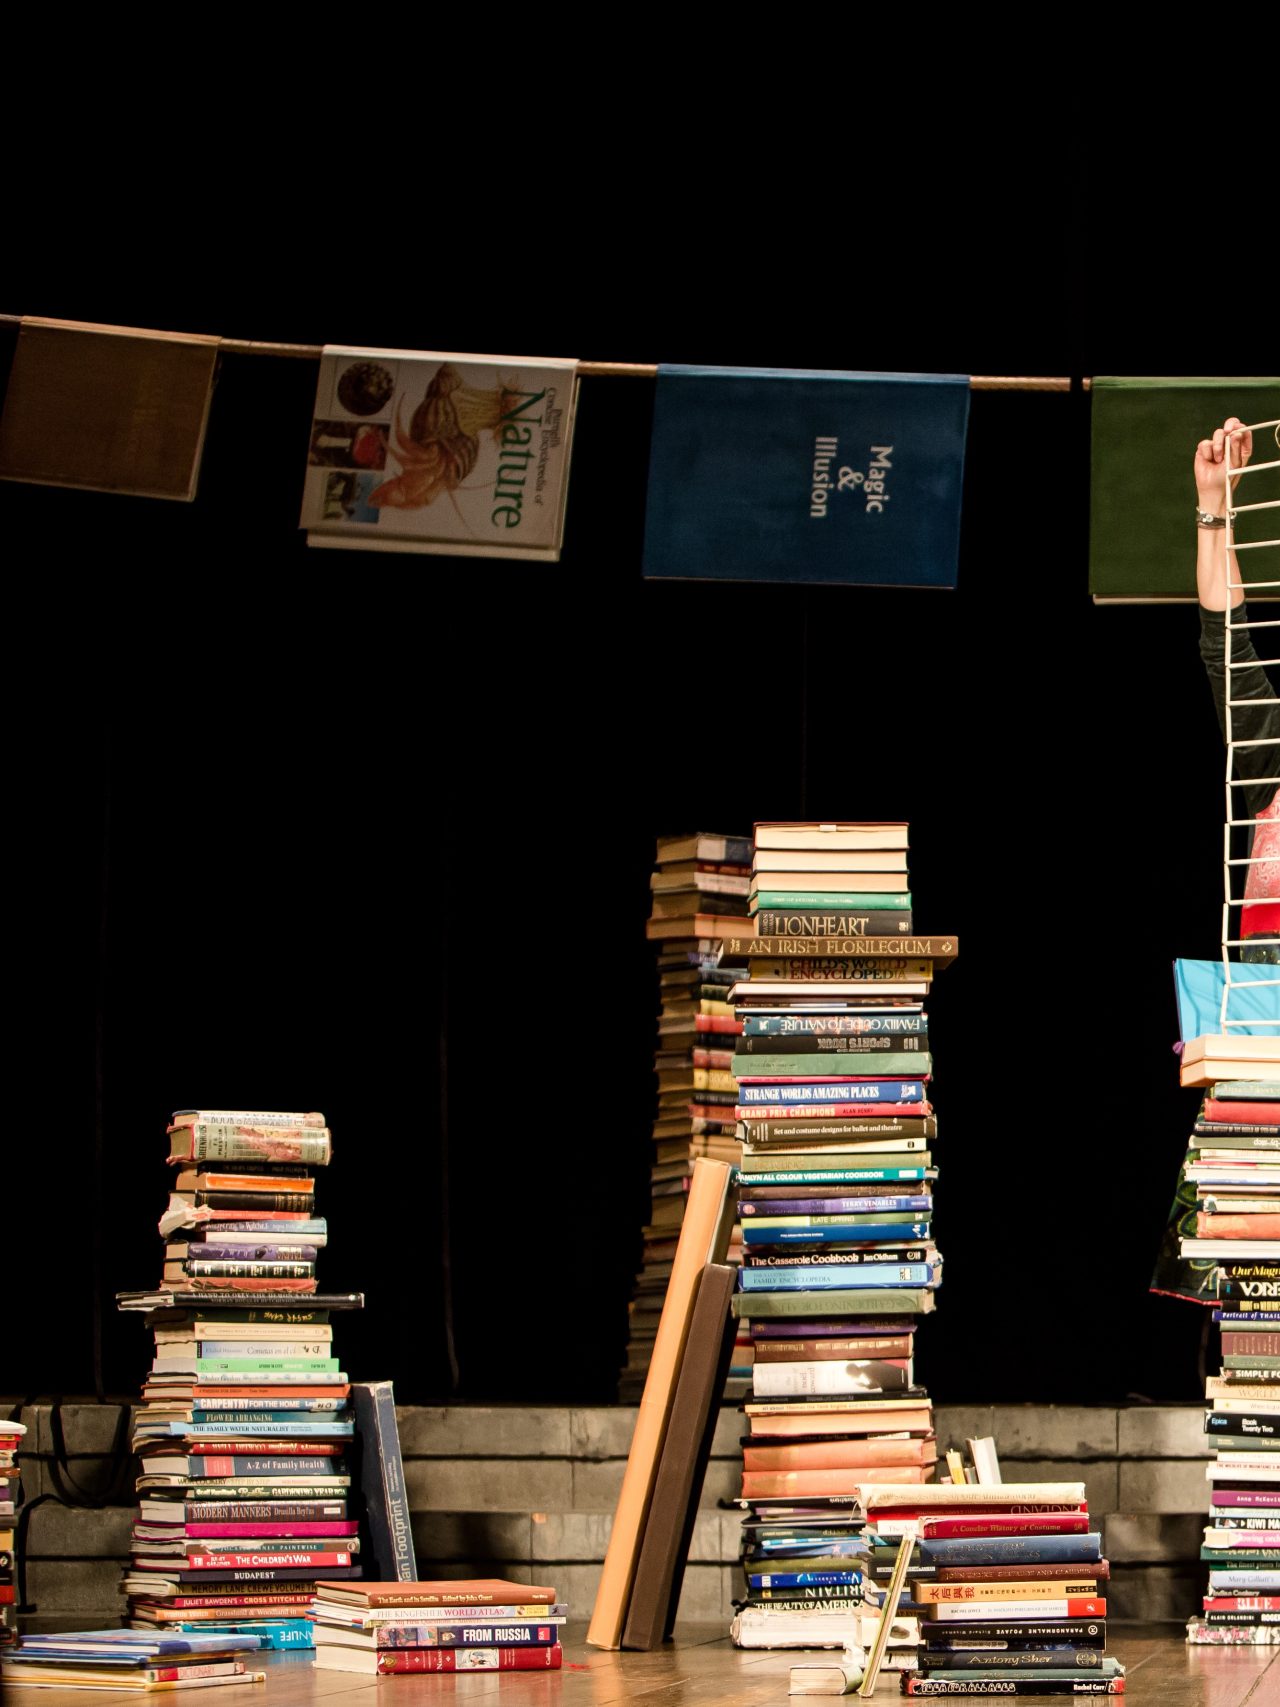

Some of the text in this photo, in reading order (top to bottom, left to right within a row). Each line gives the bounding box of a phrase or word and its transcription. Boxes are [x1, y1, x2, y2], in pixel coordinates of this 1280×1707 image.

[491, 387, 546, 528] Nature
[810, 435, 838, 519] Illusion
[836, 465, 865, 492] &
[866, 445, 894, 515] Magic
[775, 916, 869, 936] LIONHEART
[747, 939, 931, 955] AN IRISH FLORILEGIUM
[789, 958, 907, 970] CHILD'S WORLD
[790, 969, 908, 980] ENCYCLOPEDIA
[781, 1019, 920, 1031] FAMILY GUIDE TO NATURE
[849, 1037, 890, 1049] SPORTS
[745, 1086, 879, 1100] STRANGE WORLDS AMAZING PLACES
[740, 1107, 835, 1119] GRAND PRIX CHAMPIONS
[819, 1126, 842, 1135] designs
[869, 1124, 880, 1132] and
[803, 1172, 844, 1180] VEGETARIAN
[844, 1171, 884, 1179] COOKBOOK
[842, 1199, 896, 1208] TERRY VENABLES
[750, 1254, 859, 1266] The Casserole Cookbook
[1232, 1266, 1252, 1276] Our
[1236, 1370, 1269, 1378] SIMPLE
[200, 1399, 249, 1409] CARPENTRY
[1211, 1418, 1227, 1426] Epica
[1242, 1418, 1257, 1426] Book
[1242, 1425, 1261, 1433] Twenty
[272, 1462, 298, 1470] Family
[192, 1507, 271, 1519] MODERN MANNERS
[990, 1524, 1017, 1533] History
[1247, 1519, 1266, 1528] KIWI
[391, 1499, 409, 1562] Footprint
[235, 1556, 250, 1565] THE
[252, 1555, 293, 1564] CHILDREN'S
[192, 1584, 305, 1593] MEMORY LANE CREWE VOLUME
[244, 1596, 267, 1604] CROSS
[815, 1600, 864, 1610] AMERICA
[1237, 1597, 1273, 1610] BLUE
[478, 1608, 505, 1616] ATLAS
[463, 1627, 531, 1642] FROM RUSSIA
[1028, 1627, 1083, 1635] PARANORMALNE
[968, 1653, 1053, 1665] Antony Sher
